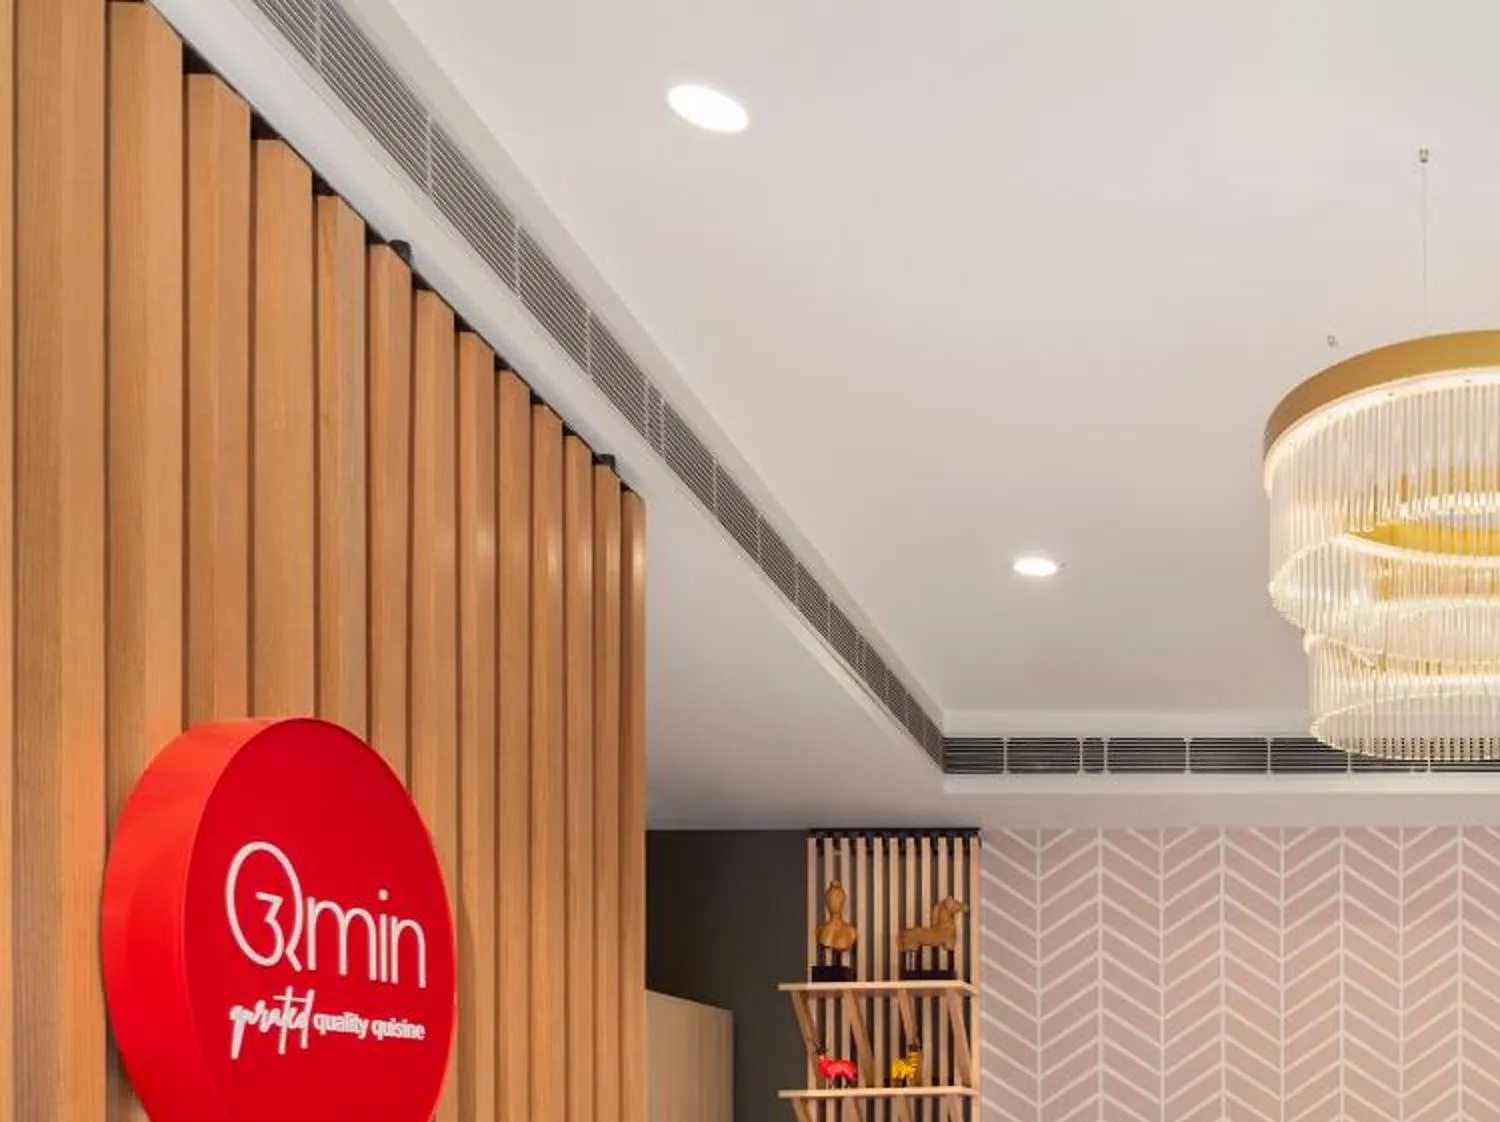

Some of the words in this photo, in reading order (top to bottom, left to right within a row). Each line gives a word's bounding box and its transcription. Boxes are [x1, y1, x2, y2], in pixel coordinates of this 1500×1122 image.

[225, 841, 427, 989] Qmin
[312, 1011, 369, 1040] quality
[370, 1017, 427, 1041] quisine
